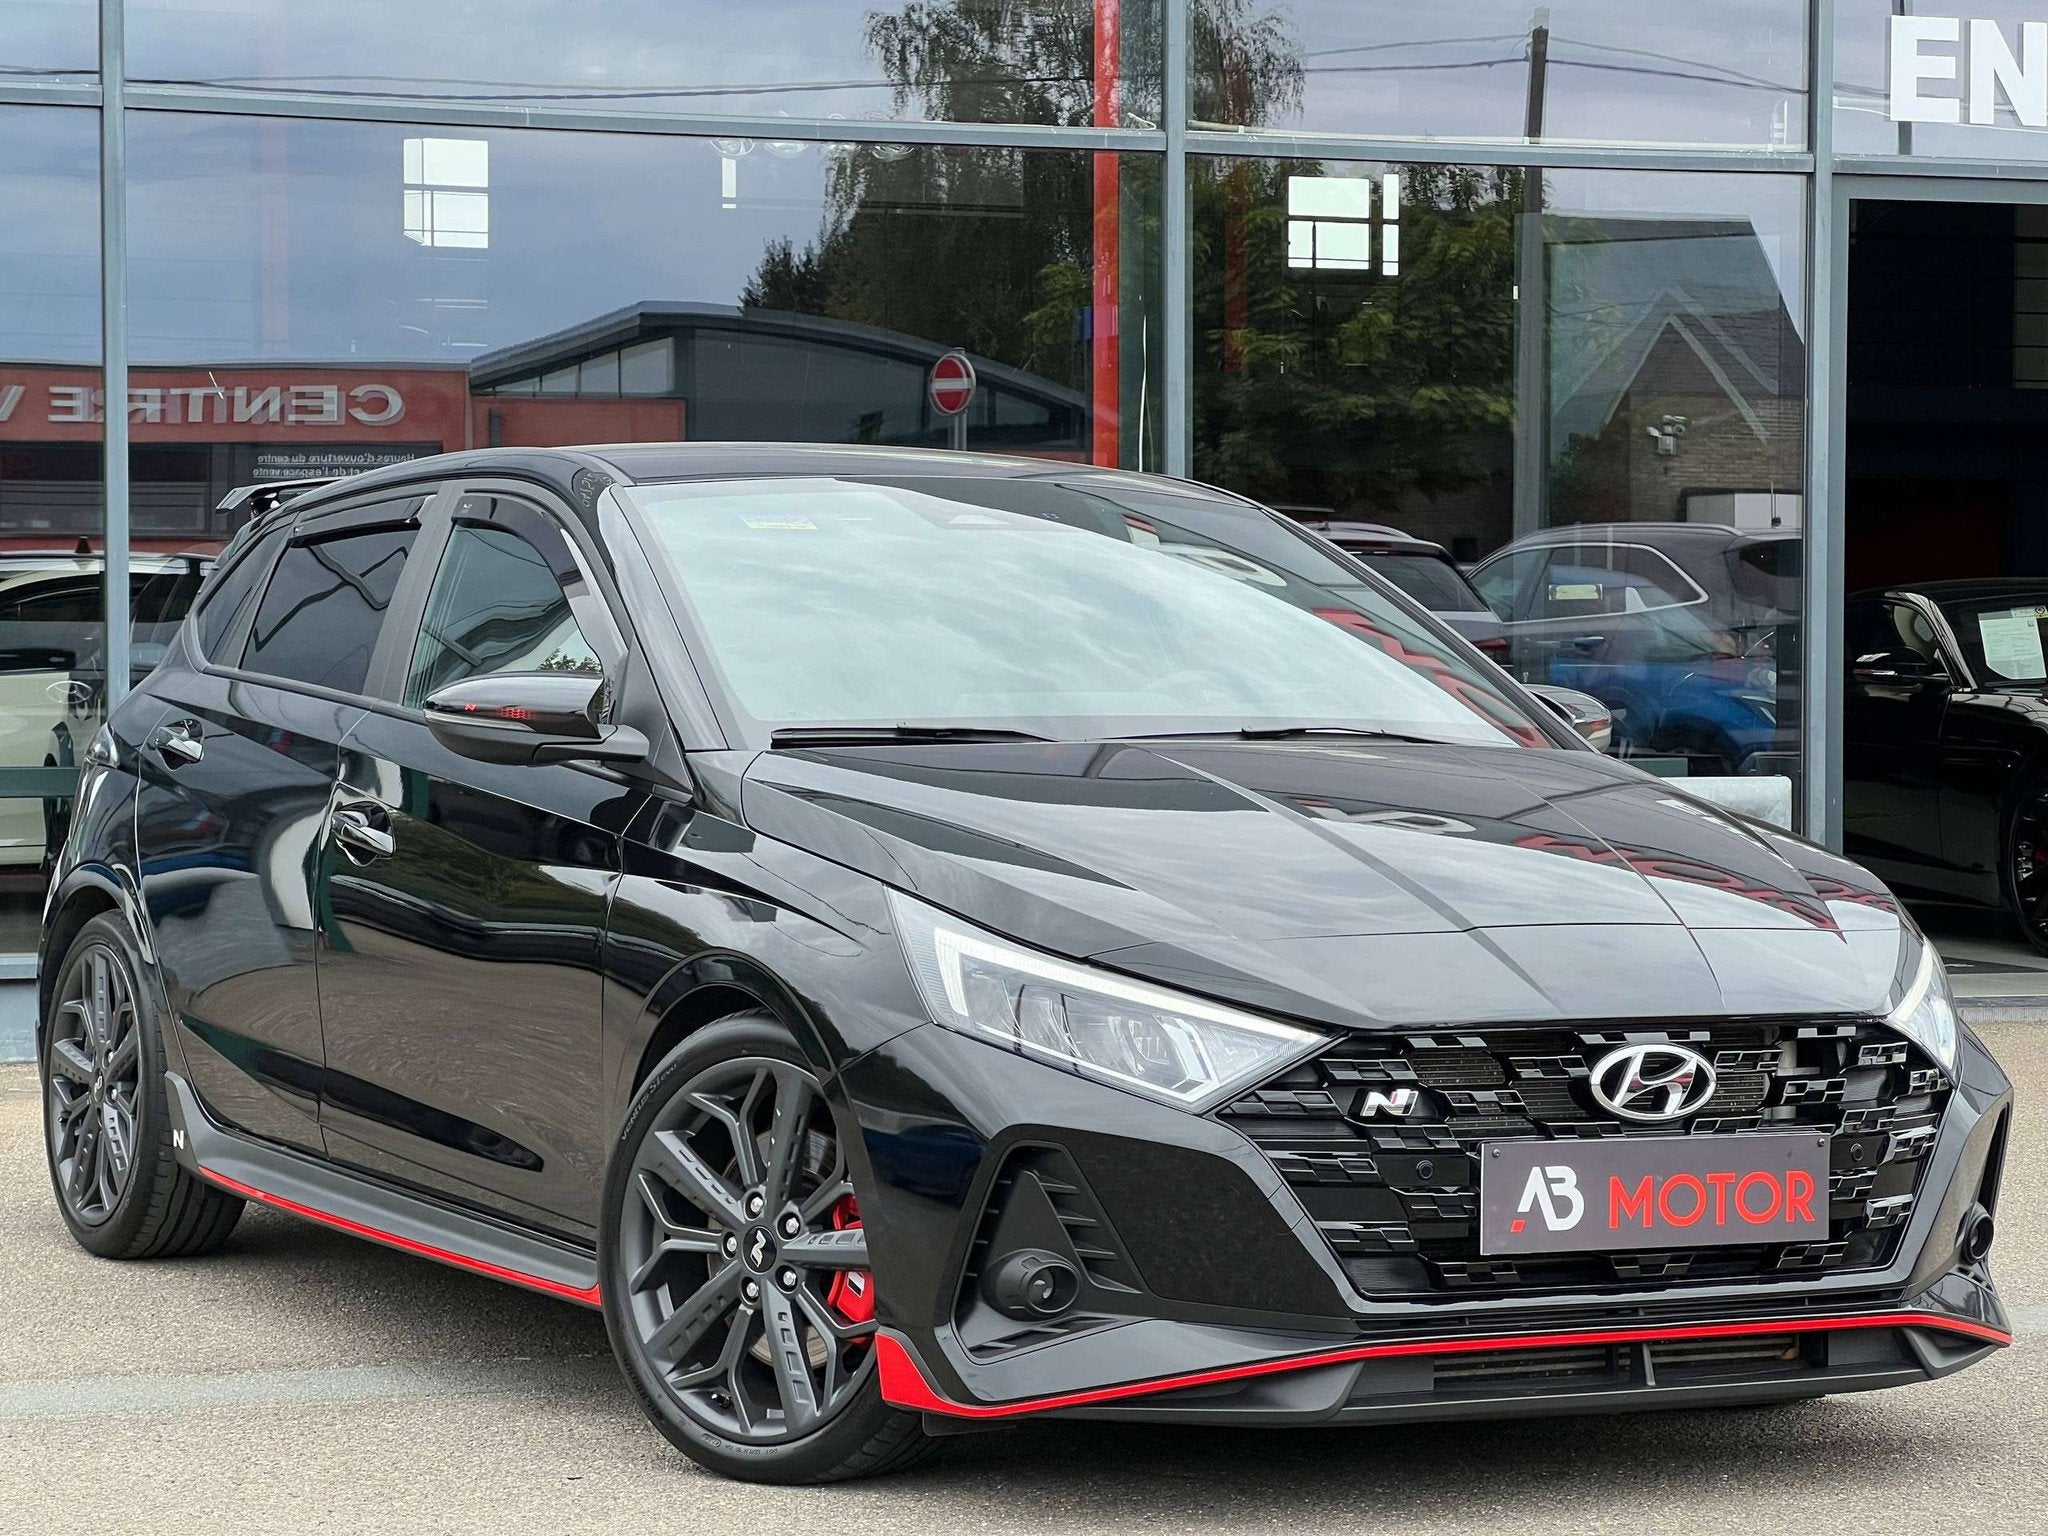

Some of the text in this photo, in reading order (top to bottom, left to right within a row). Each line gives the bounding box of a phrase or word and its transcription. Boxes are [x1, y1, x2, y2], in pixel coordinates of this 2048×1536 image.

[1889, 14, 2048, 126] EN
[173, 1128, 184, 1150] N
[1608, 1170, 1816, 1229] MOTOR
